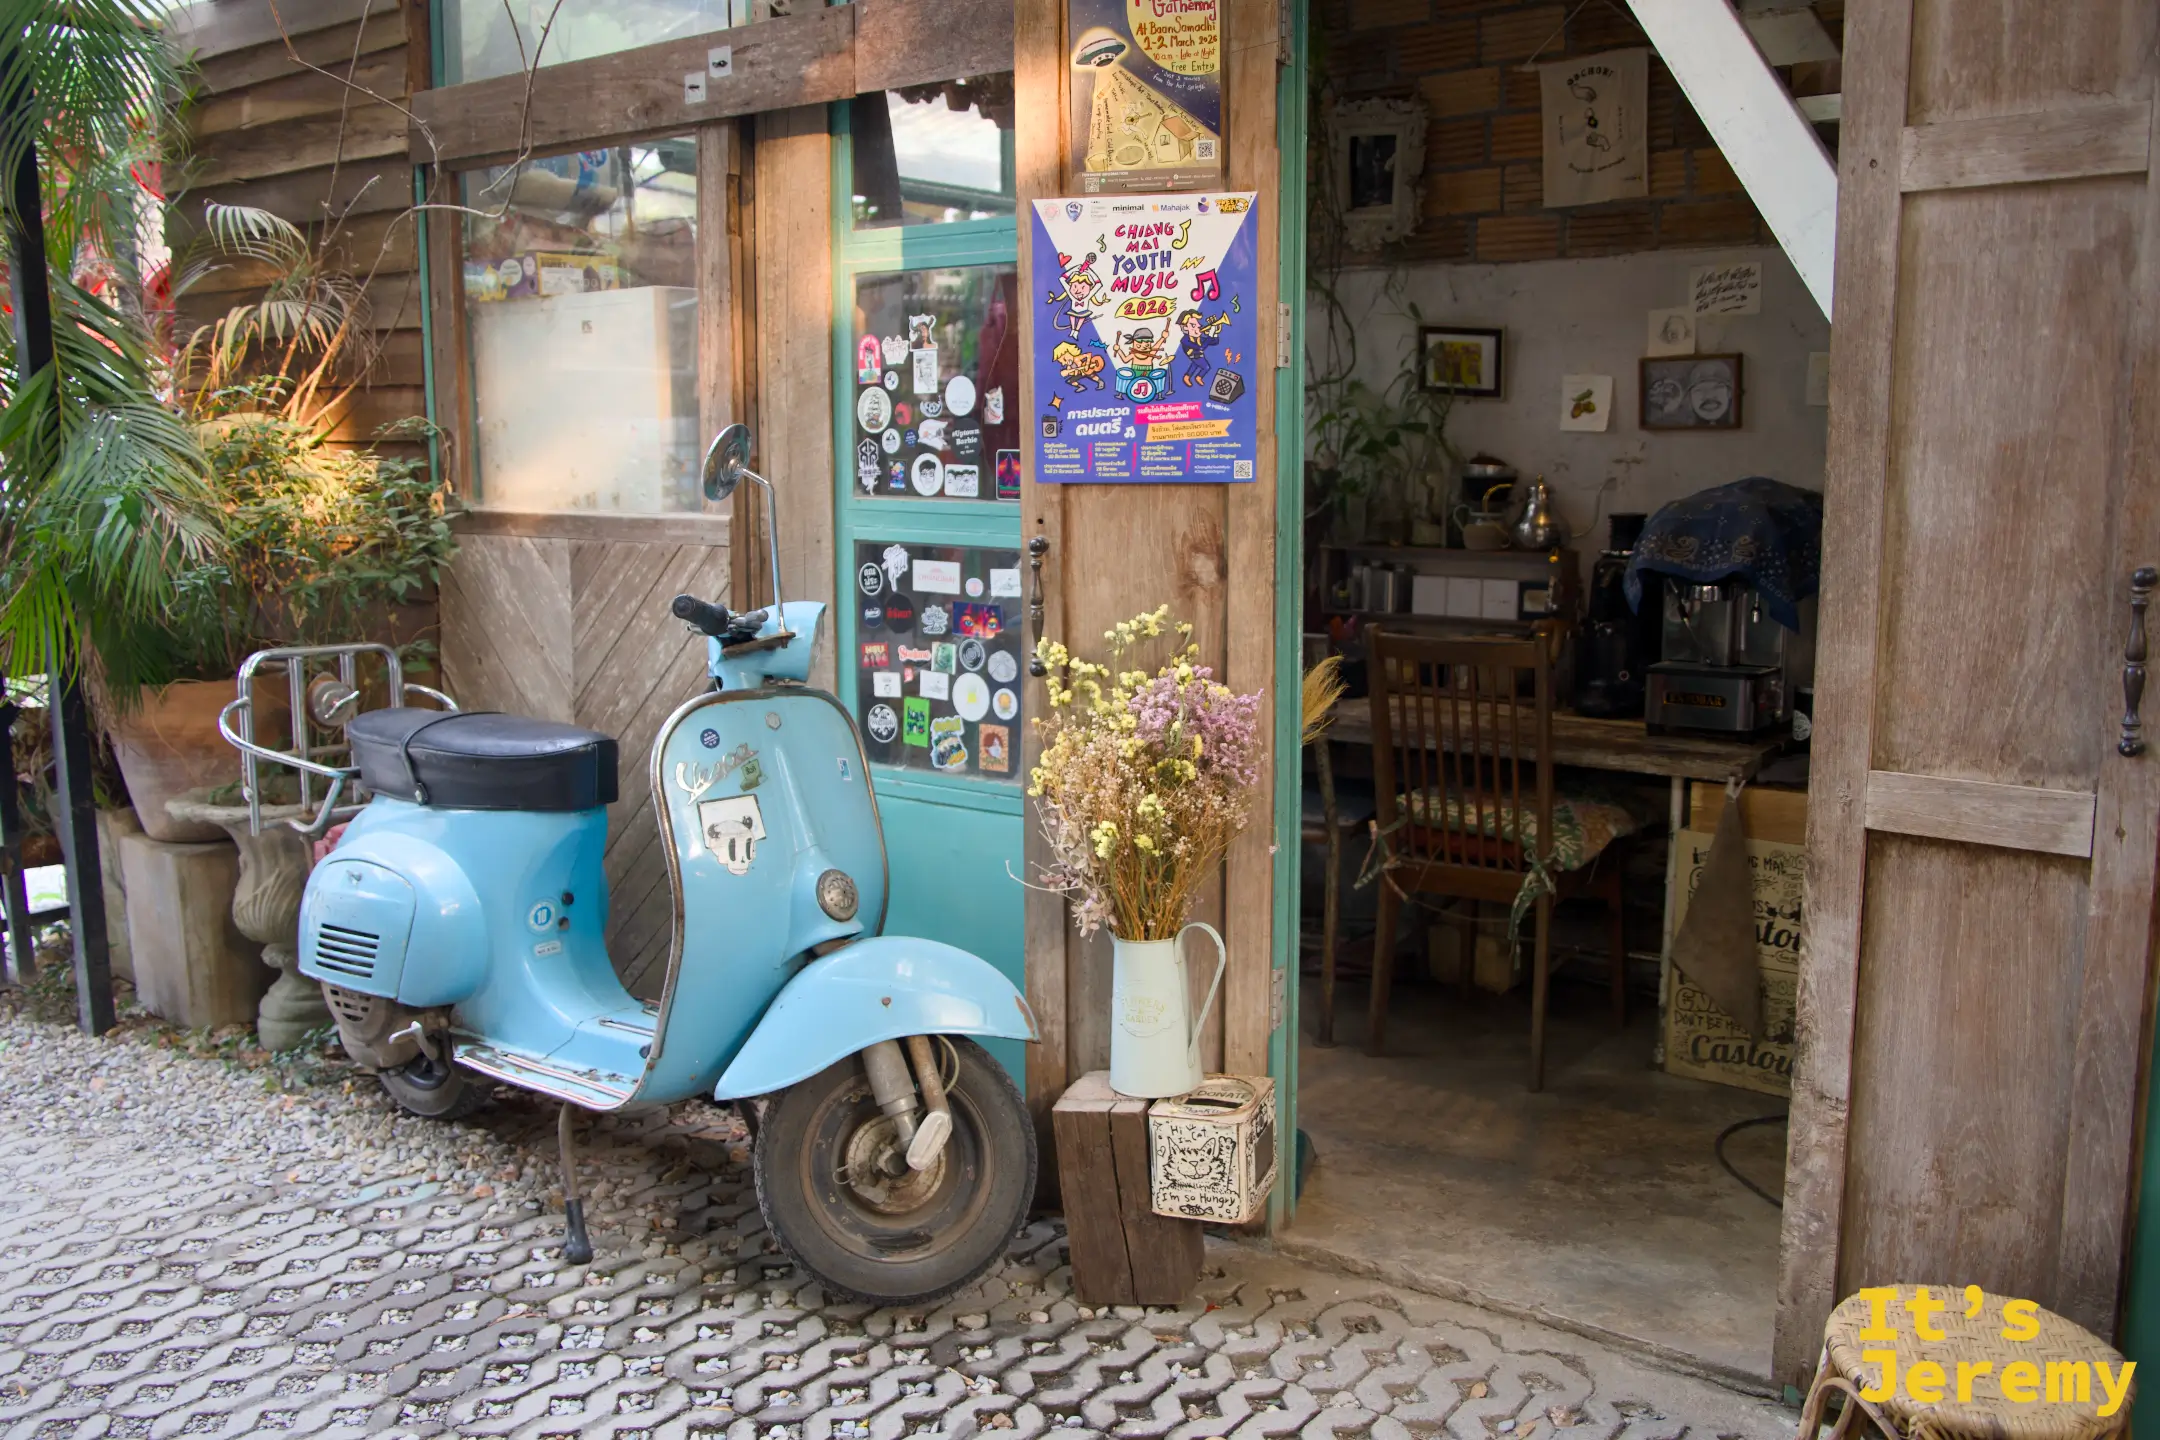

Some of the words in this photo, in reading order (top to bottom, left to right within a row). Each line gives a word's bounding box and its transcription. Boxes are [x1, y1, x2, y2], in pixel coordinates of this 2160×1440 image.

[1170, 34, 1196, 48] March
[1171, 62, 1187, 72] Free
[1191, 60, 1215, 73] Entry
[1112, 204, 1145, 212] minimal
[1160, 204, 1191, 213] Mahajak
[1114, 221, 1175, 240] CHIANG
[1125, 237, 1160, 253] MAI
[1112, 250, 1172, 276] YOUTH
[1110, 271, 1179, 297] MUSIC
[1123, 299, 1168, 317] 2026
[1067, 406, 1131, 420] การประกวด
[1075, 416, 1123, 437] ดนตรี
[676, 742, 760, 807] Vespa
[1197, 1090, 1247, 1099] DONATE
[1170, 1125, 1183, 1136] Hi
[1162, 1192, 1180, 1202] I'm
[1184, 1194, 1196, 1203] so
[1200, 1193, 1236, 1209] Hungry
